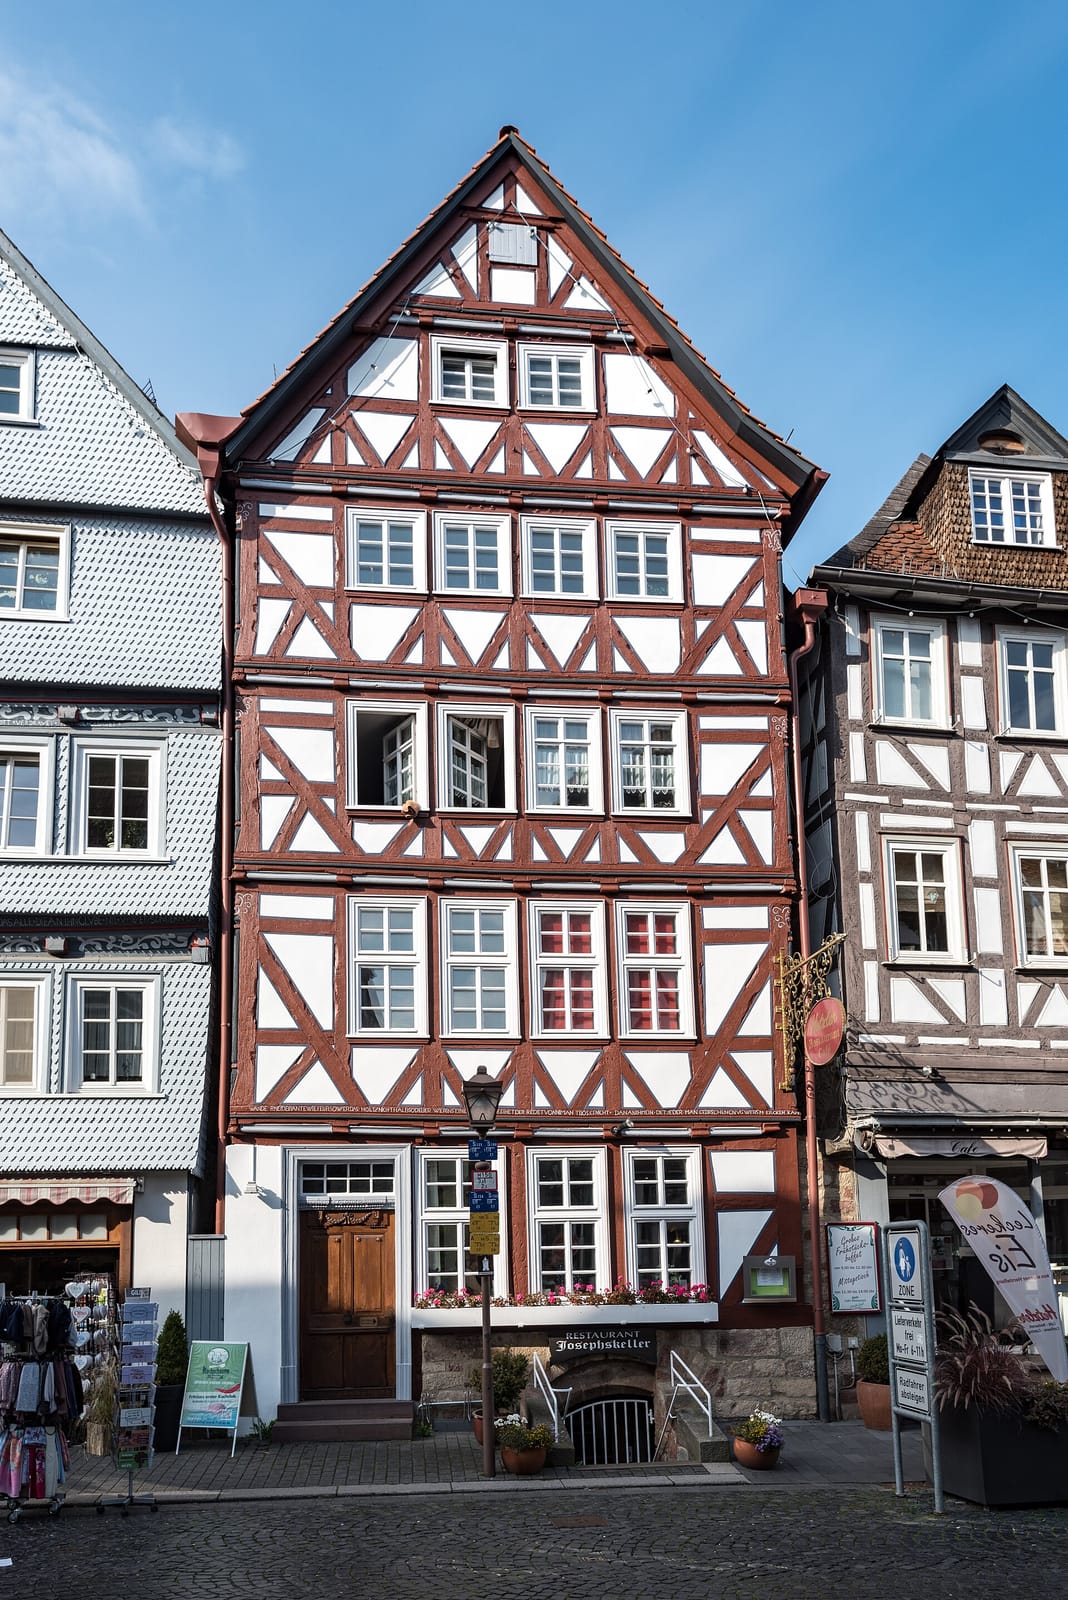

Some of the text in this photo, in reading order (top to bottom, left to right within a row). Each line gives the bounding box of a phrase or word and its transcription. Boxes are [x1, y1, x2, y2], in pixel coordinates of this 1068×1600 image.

[898, 1284, 915, 1297] ZONE
[894, 1314, 922, 1328] Lieferverkehr
[566, 1331, 640, 1340] RESTAURANT
[904, 1329, 914, 1341] frei
[556, 1339, 651, 1351] Josephskeller
[896, 1342, 909, 1355] Mo-Fr
[899, 1376, 925, 1391] Radfahrer
[900, 1389, 926, 1405] absteigen
